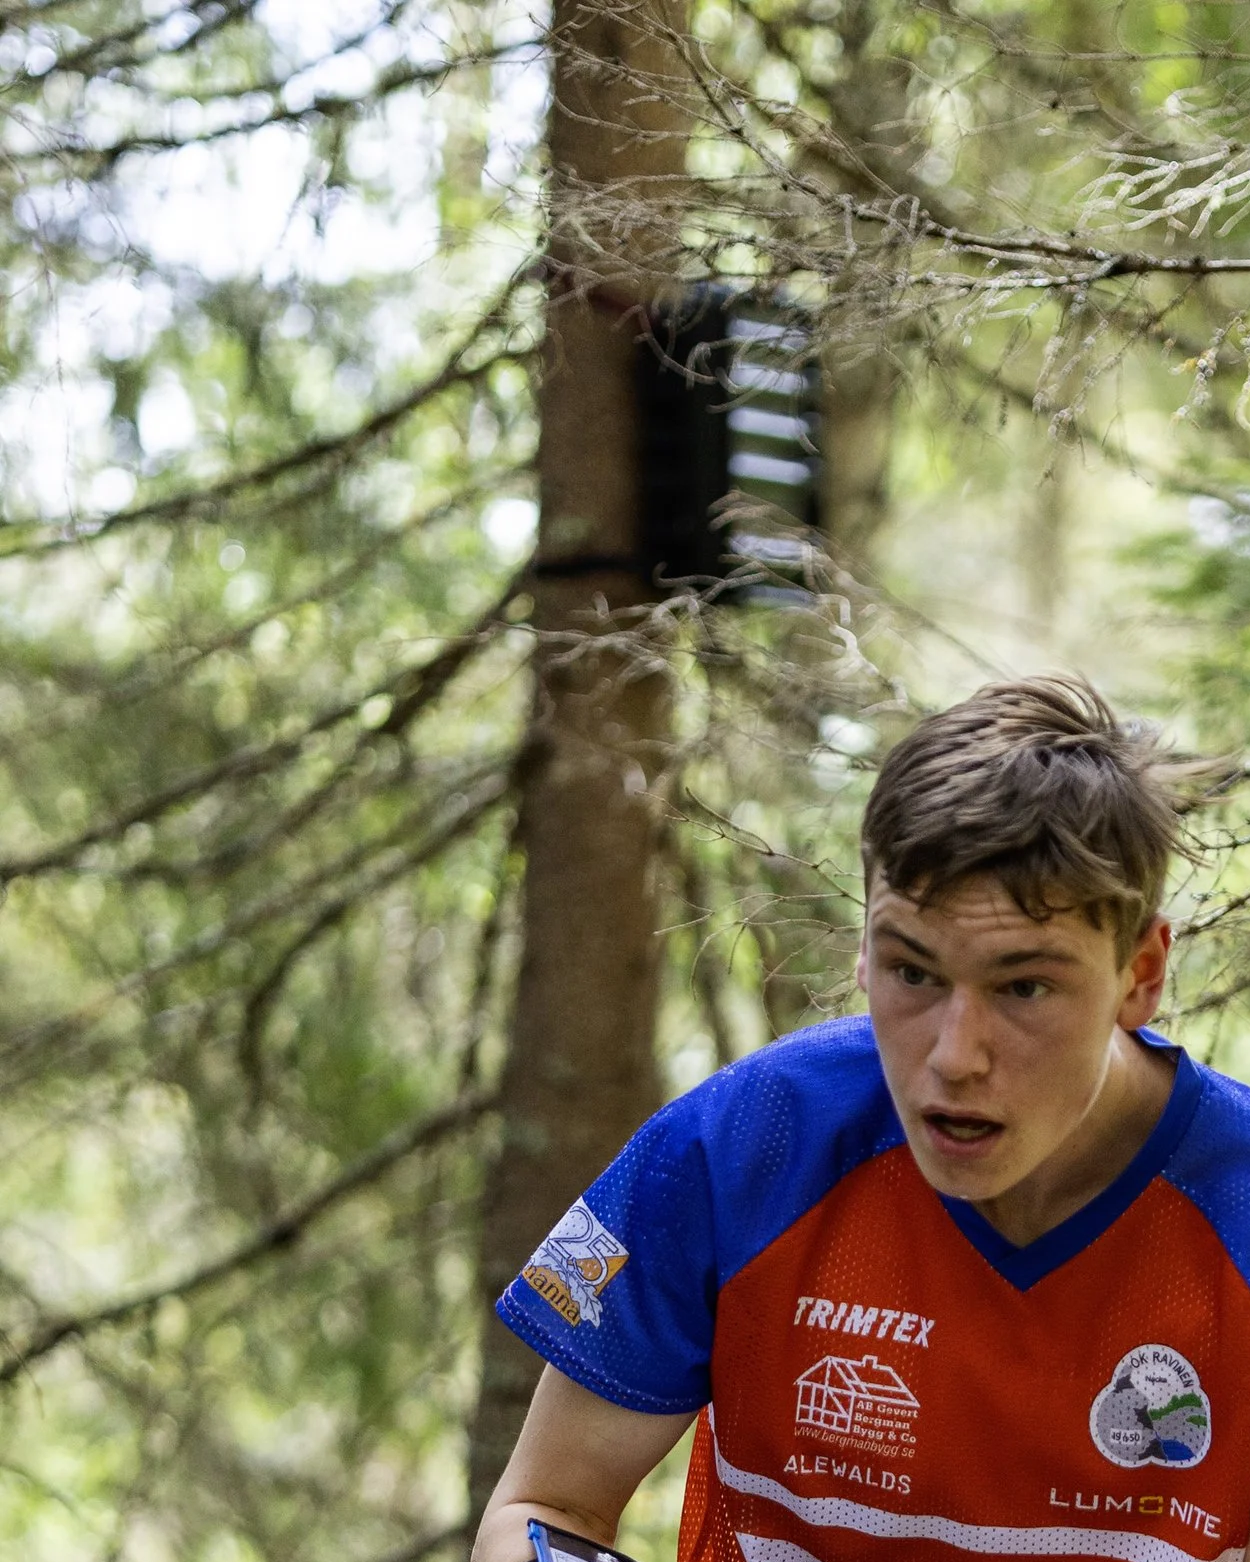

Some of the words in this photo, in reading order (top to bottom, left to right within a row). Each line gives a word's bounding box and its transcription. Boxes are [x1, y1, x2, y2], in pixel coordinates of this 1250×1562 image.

[547, 1205, 619, 1288] 25
[793, 1296, 935, 1348] TRIMTEX
[1130, 1352, 1148, 1368] OK
[1152, 1351, 1194, 1389] RAVINEN
[854, 1412, 911, 1430] Bergman
[856, 1400, 873, 1412] AB
[877, 1403, 919, 1418] Gevert
[853, 1425, 884, 1441] Bygg
[887, 1430, 897, 1441] &
[901, 1433, 917, 1444] Co
[784, 1454, 912, 1494] ALEWALDS
[1049, 1487, 1222, 1538] LUMONITE
